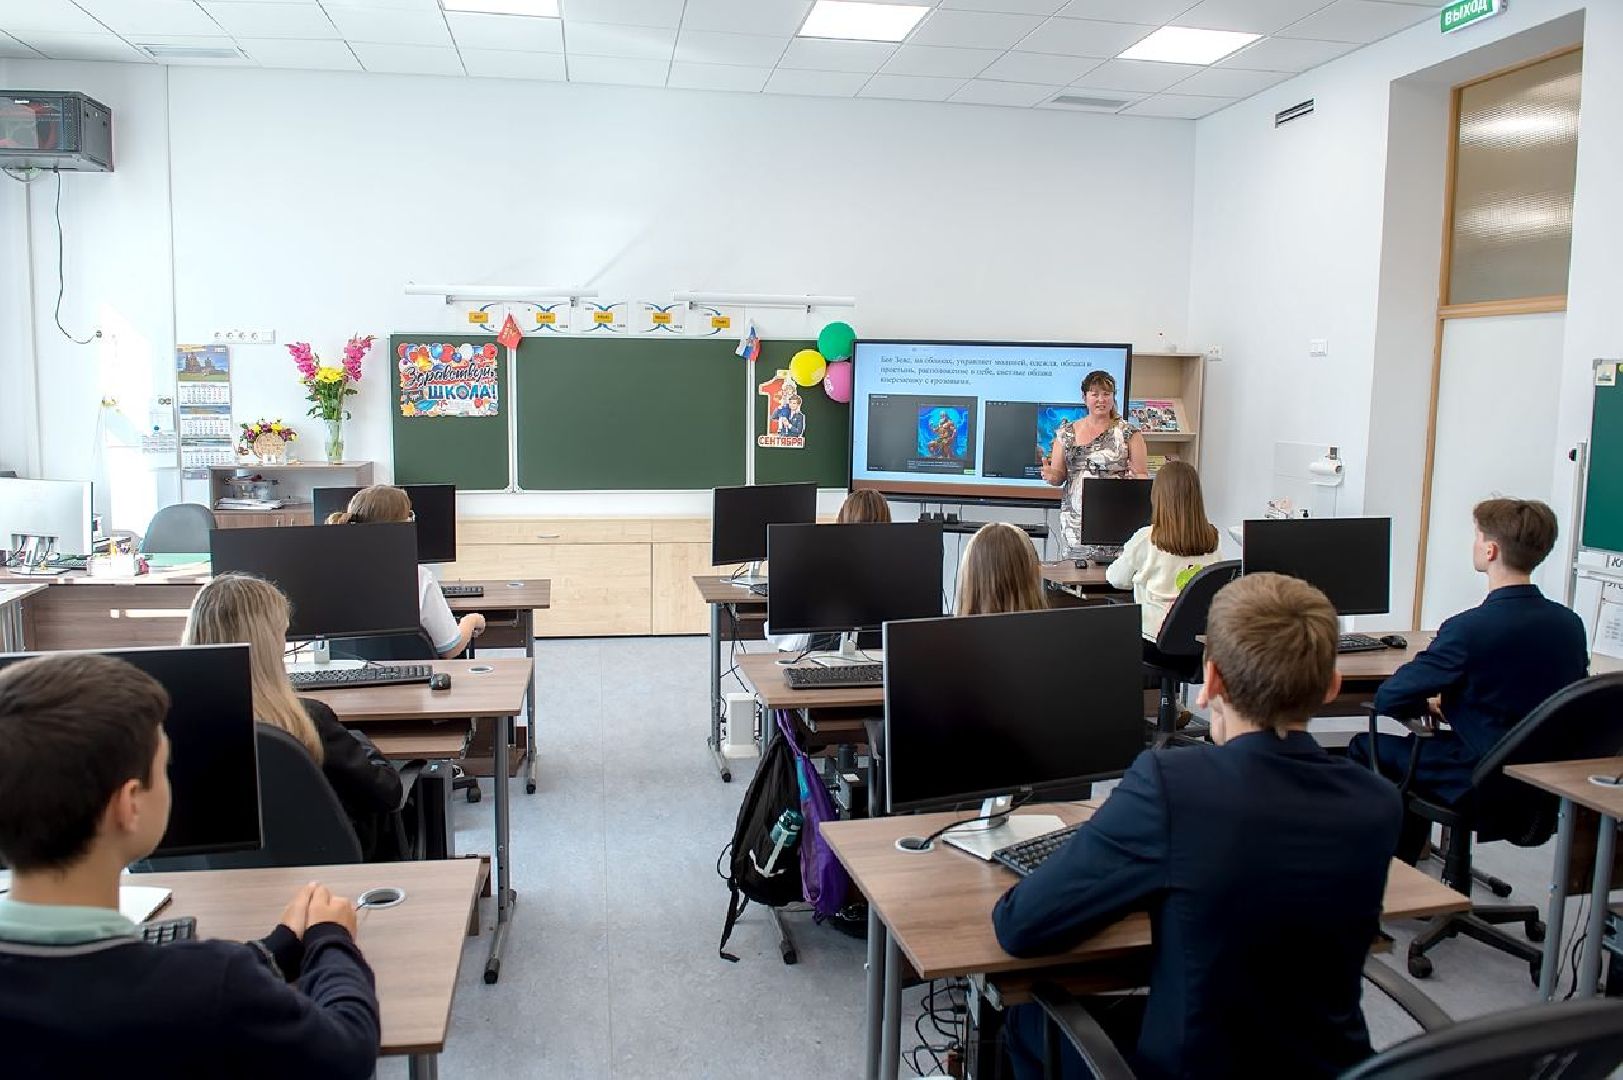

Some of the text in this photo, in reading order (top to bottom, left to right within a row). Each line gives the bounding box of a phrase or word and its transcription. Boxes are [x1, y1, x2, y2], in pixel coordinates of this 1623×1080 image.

[1445, 0, 1488, 26] ВЫХОД
[428, 384, 496, 400] ШКОЛА!
[759, 436, 803, 447] СЕНТЯБРЯ
